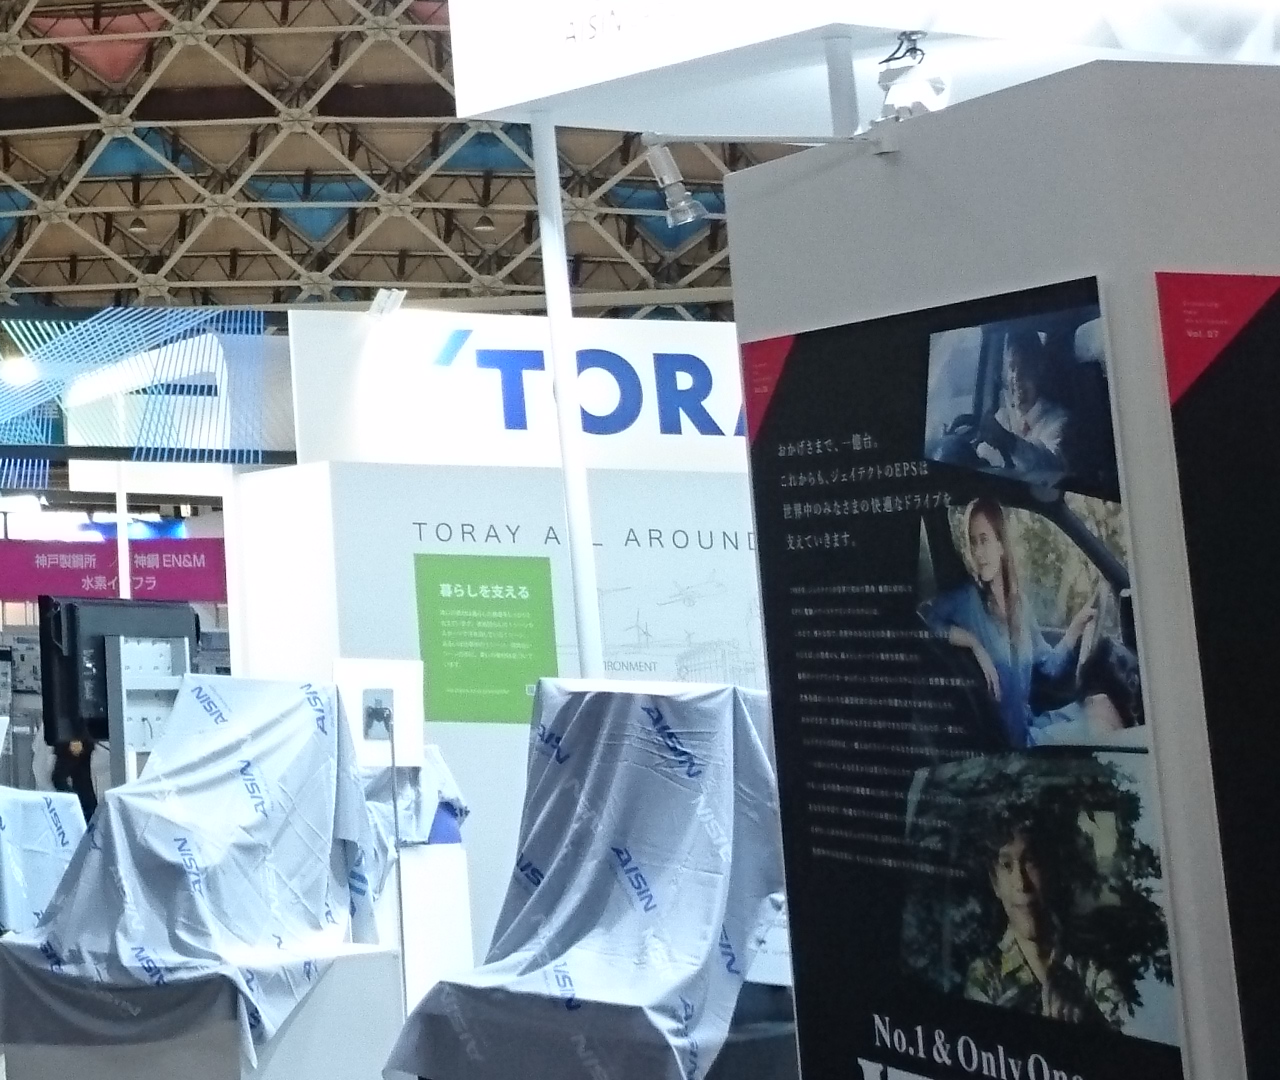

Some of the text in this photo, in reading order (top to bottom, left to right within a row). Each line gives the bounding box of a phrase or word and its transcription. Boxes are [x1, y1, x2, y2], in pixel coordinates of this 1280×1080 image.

[412, 522, 520, 544] TORAY
[34, 553, 97, 569] 神戸製鋼所
[163, 554, 206, 568] EN&M
[440, 583, 530, 599] 暮らしを支える
[191, 685, 228, 726] AISIN
[240, 759, 268, 819] AISIN
[43, 796, 70, 847] AISIN
[173, 836, 204, 898] AISIN
[611, 846, 658, 913] AISIN
[873, 1014, 926, 1059] No.1
[932, 1029, 952, 1066] &
